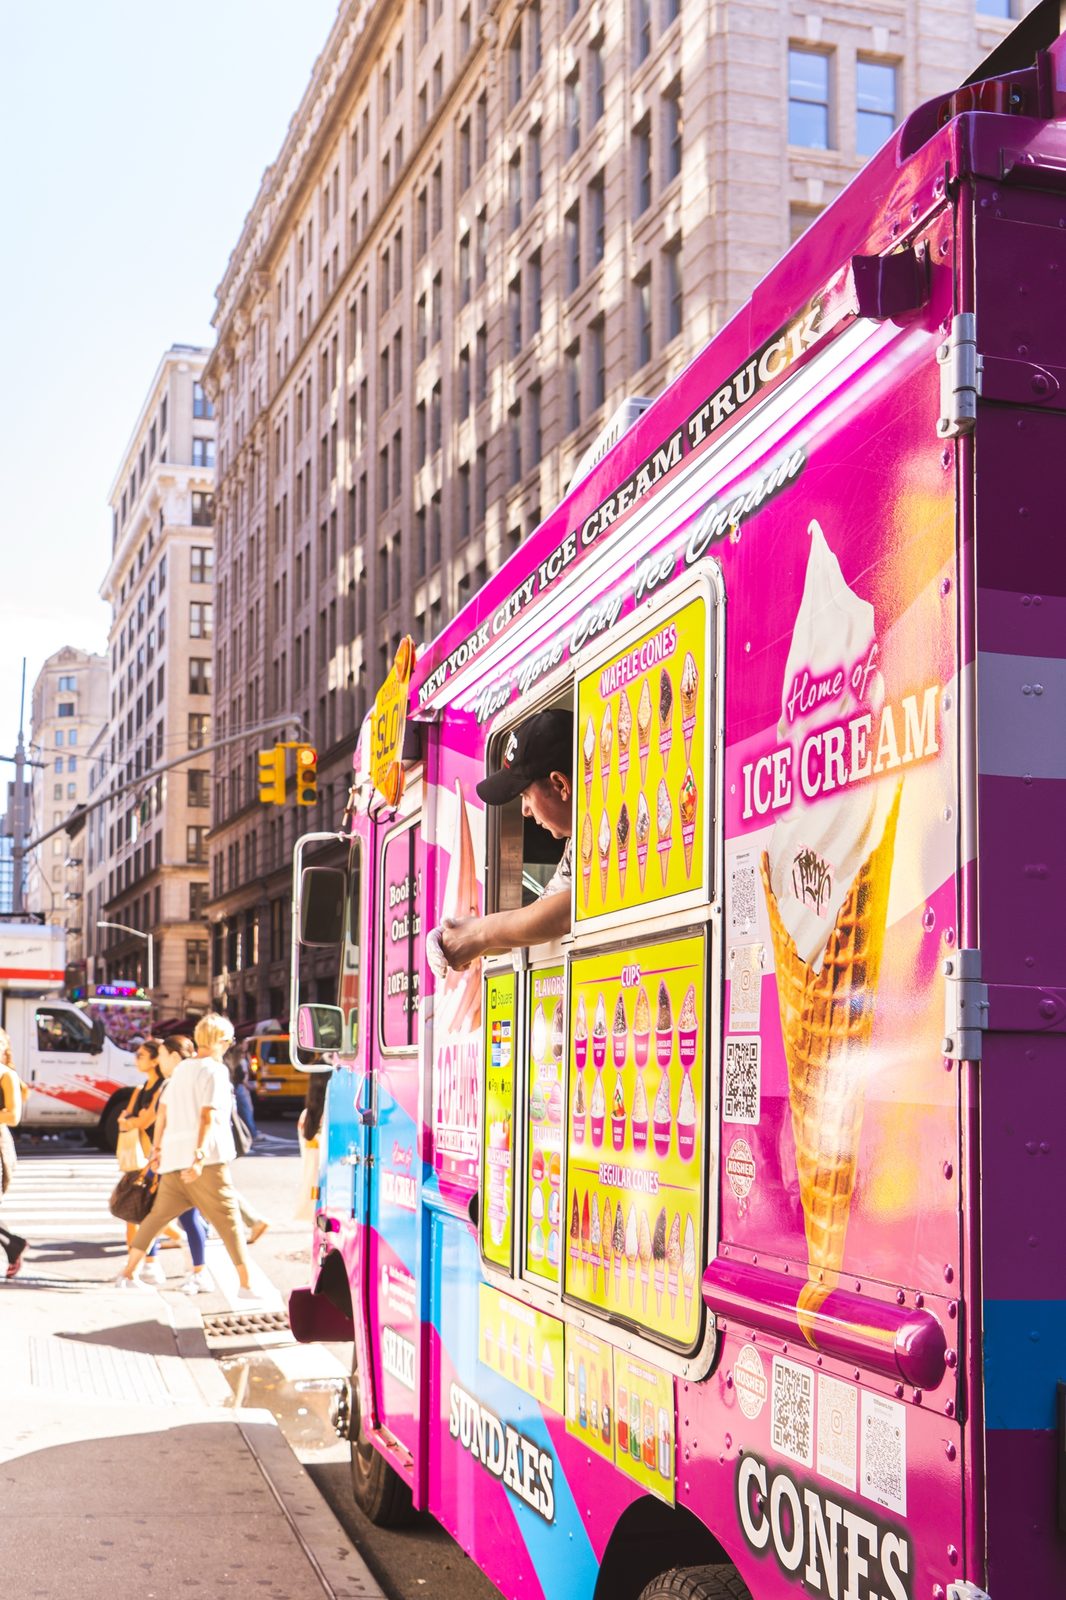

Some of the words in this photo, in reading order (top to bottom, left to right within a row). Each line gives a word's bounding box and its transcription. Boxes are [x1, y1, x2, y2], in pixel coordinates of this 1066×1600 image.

[418, 657, 453, 706] NEW
[448, 621, 491, 676] YORK
[491, 576, 536, 637] CITY
[537, 536, 579, 592] ICE
[580, 439, 684, 546] CREAM
[688, 305, 829, 449] TRUCK
[476, 683, 511, 724] New
[516, 645, 564, 692] York
[568, 592, 623, 656] City
[631, 550, 677, 599] Ice
[685, 452, 807, 563] Cream
[600, 651, 639, 696] WAFFLE
[640, 624, 677, 670] CONES
[788, 671, 843, 721] Home
[851, 643, 879, 702] of
[742, 746, 792, 819] ICE
[800, 685, 940, 798] CREAM
[621, 965, 641, 988] CUPS
[599, 1163, 632, 1190] REGULAR
[631, 1169, 660, 1194] CONES
[728, 1160, 754, 1177] KOSHER
[735, 1367, 766, 1399] KOSHER
[449, 1383, 555, 1521] SUNDAES
[737, 1456, 909, 1600] CONES
